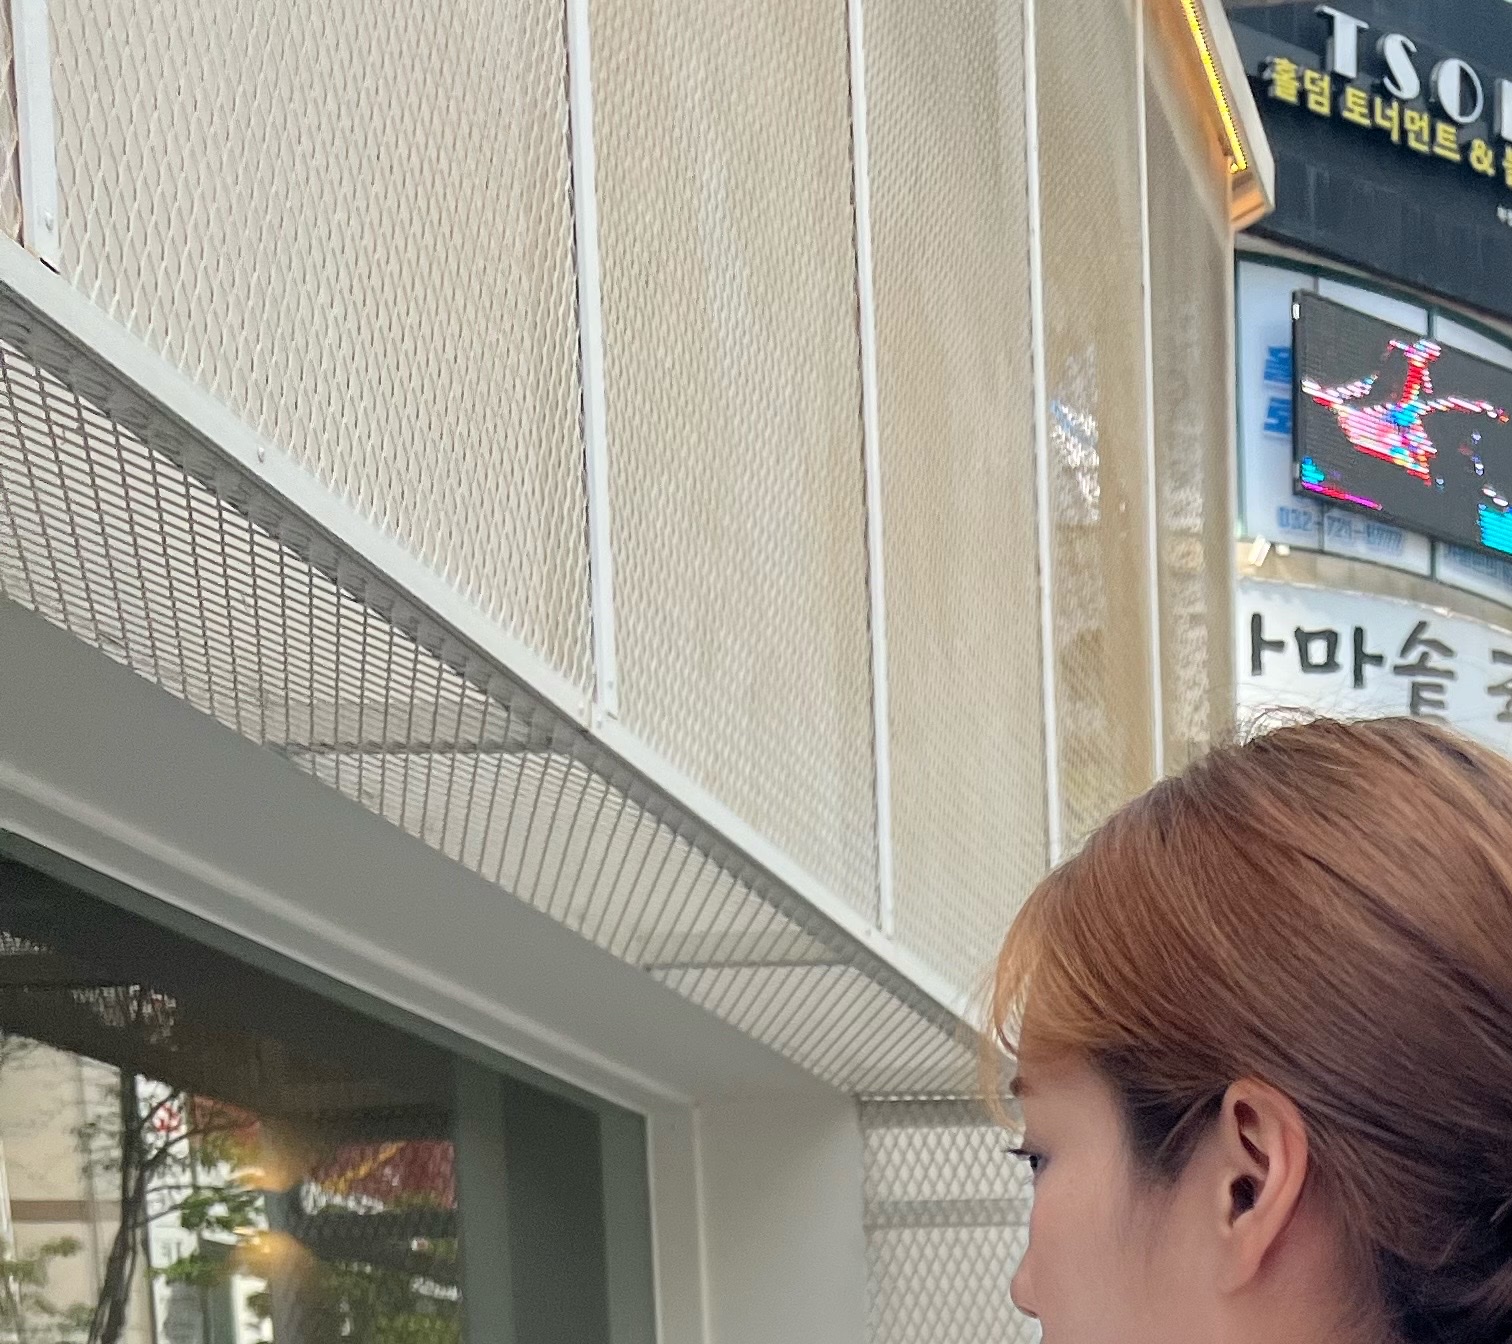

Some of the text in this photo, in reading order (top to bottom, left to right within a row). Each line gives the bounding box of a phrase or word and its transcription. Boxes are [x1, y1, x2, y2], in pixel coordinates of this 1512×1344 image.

[1273, 57, 1331, 117] 홀덤
[1342, 85, 1461, 162] 토너먼트
[1469, 138, 1496, 176] &
